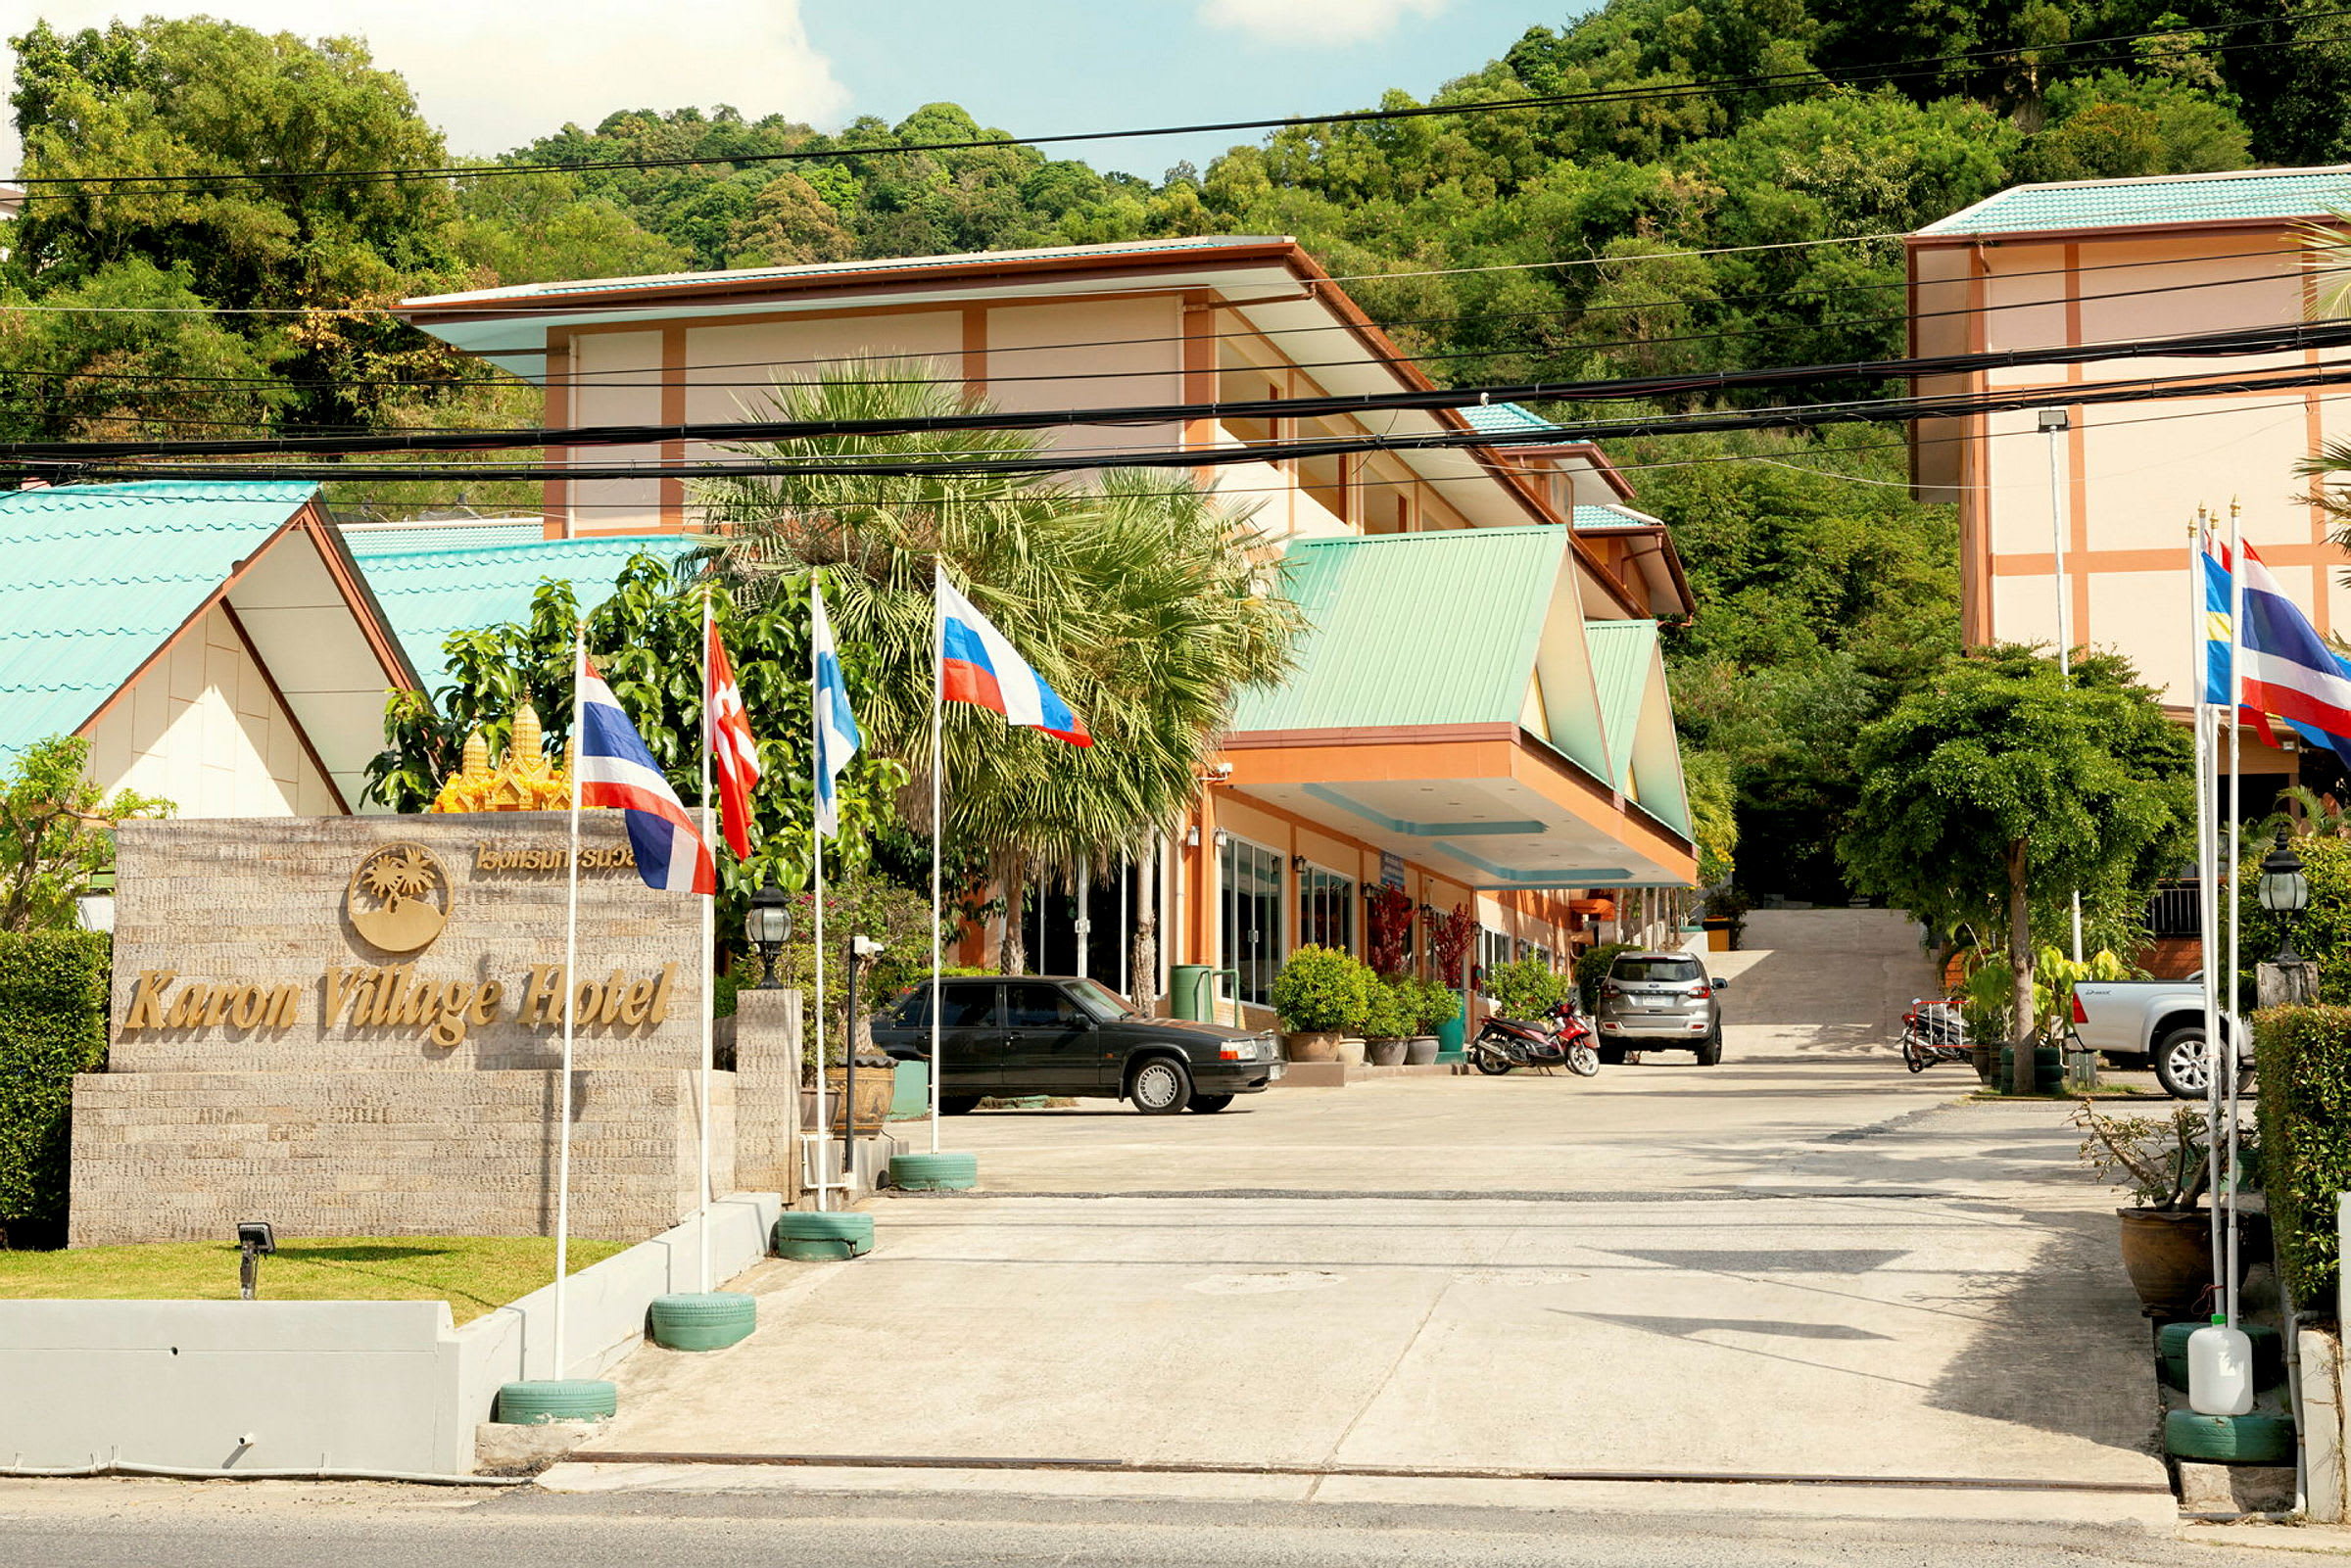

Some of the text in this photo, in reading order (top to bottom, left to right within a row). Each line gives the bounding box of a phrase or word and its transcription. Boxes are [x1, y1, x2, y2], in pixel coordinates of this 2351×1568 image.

[125, 961, 678, 1047] Karon Village Hotel
